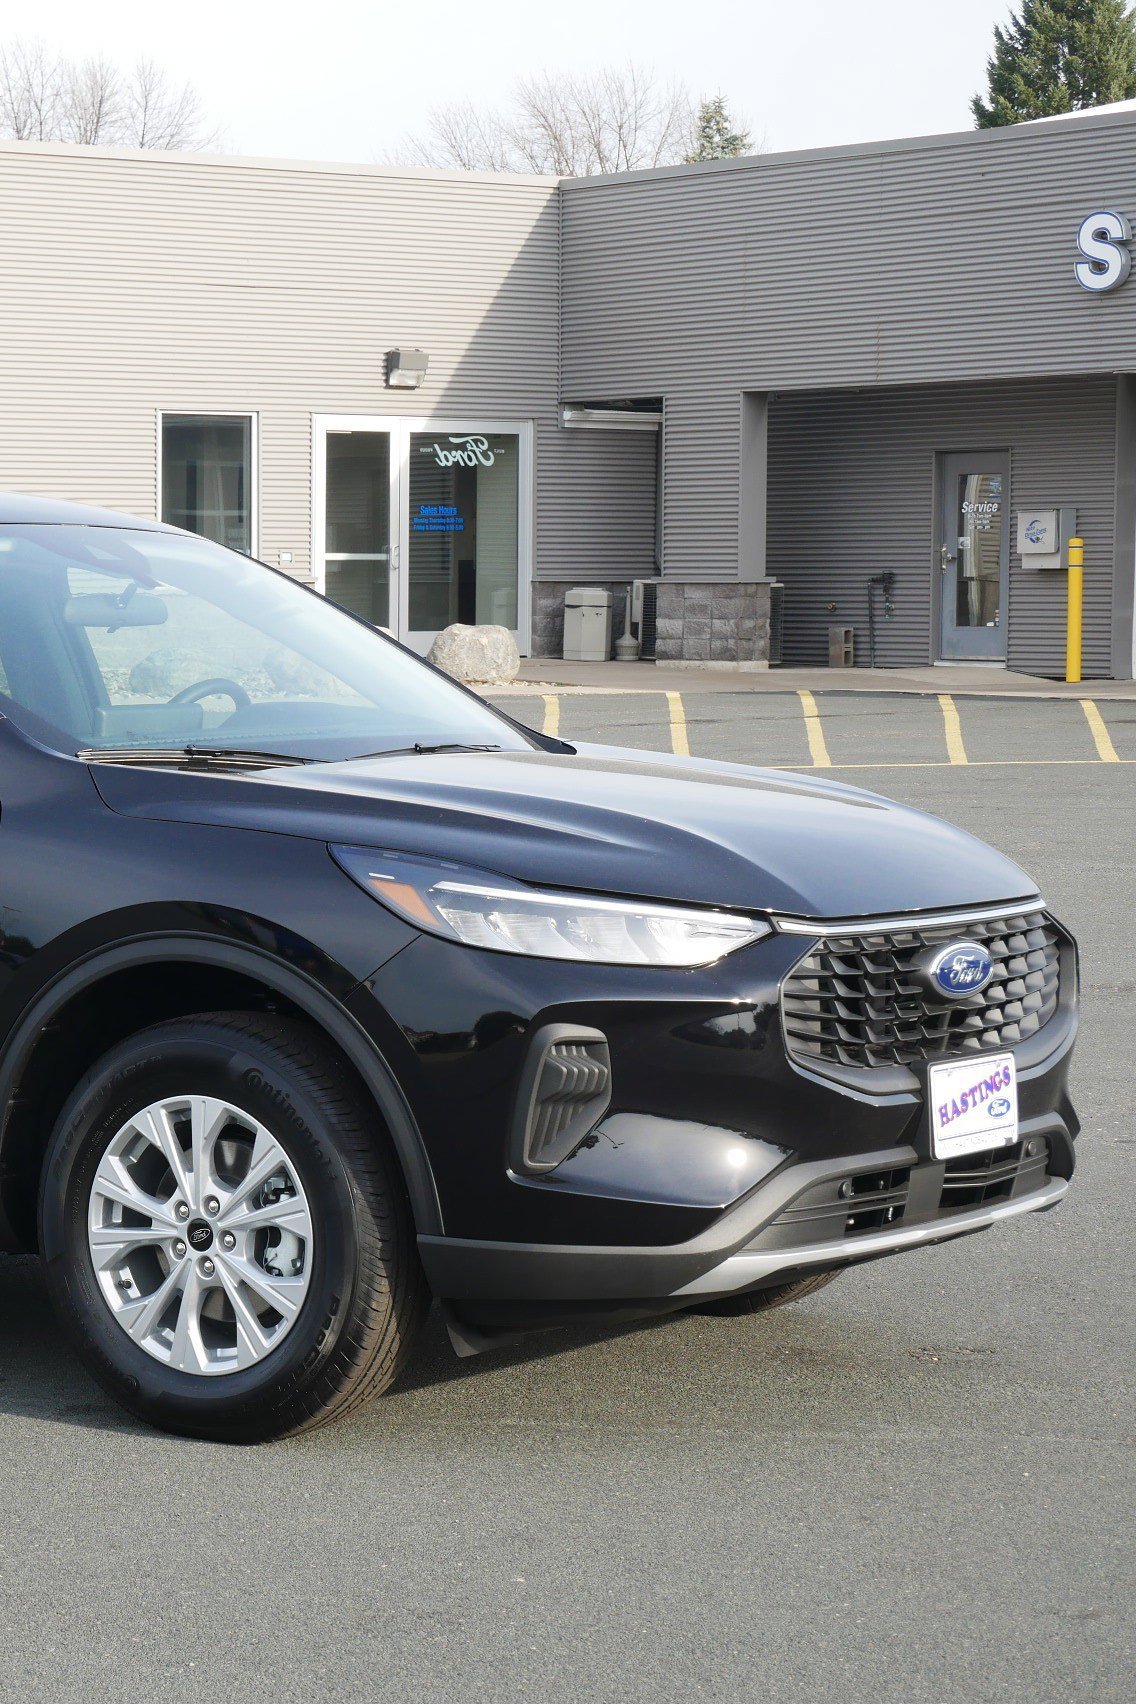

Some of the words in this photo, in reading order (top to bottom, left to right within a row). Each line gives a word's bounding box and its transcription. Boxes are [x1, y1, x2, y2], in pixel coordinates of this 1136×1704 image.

[1074, 211, 1129, 291] S
[419, 505, 438, 515] Sales
[438, 505, 457, 515] Hours
[961, 501, 998, 513] Service
[949, 955, 983, 985] Ford
[938, 1065, 1011, 1128] HASTINGS
